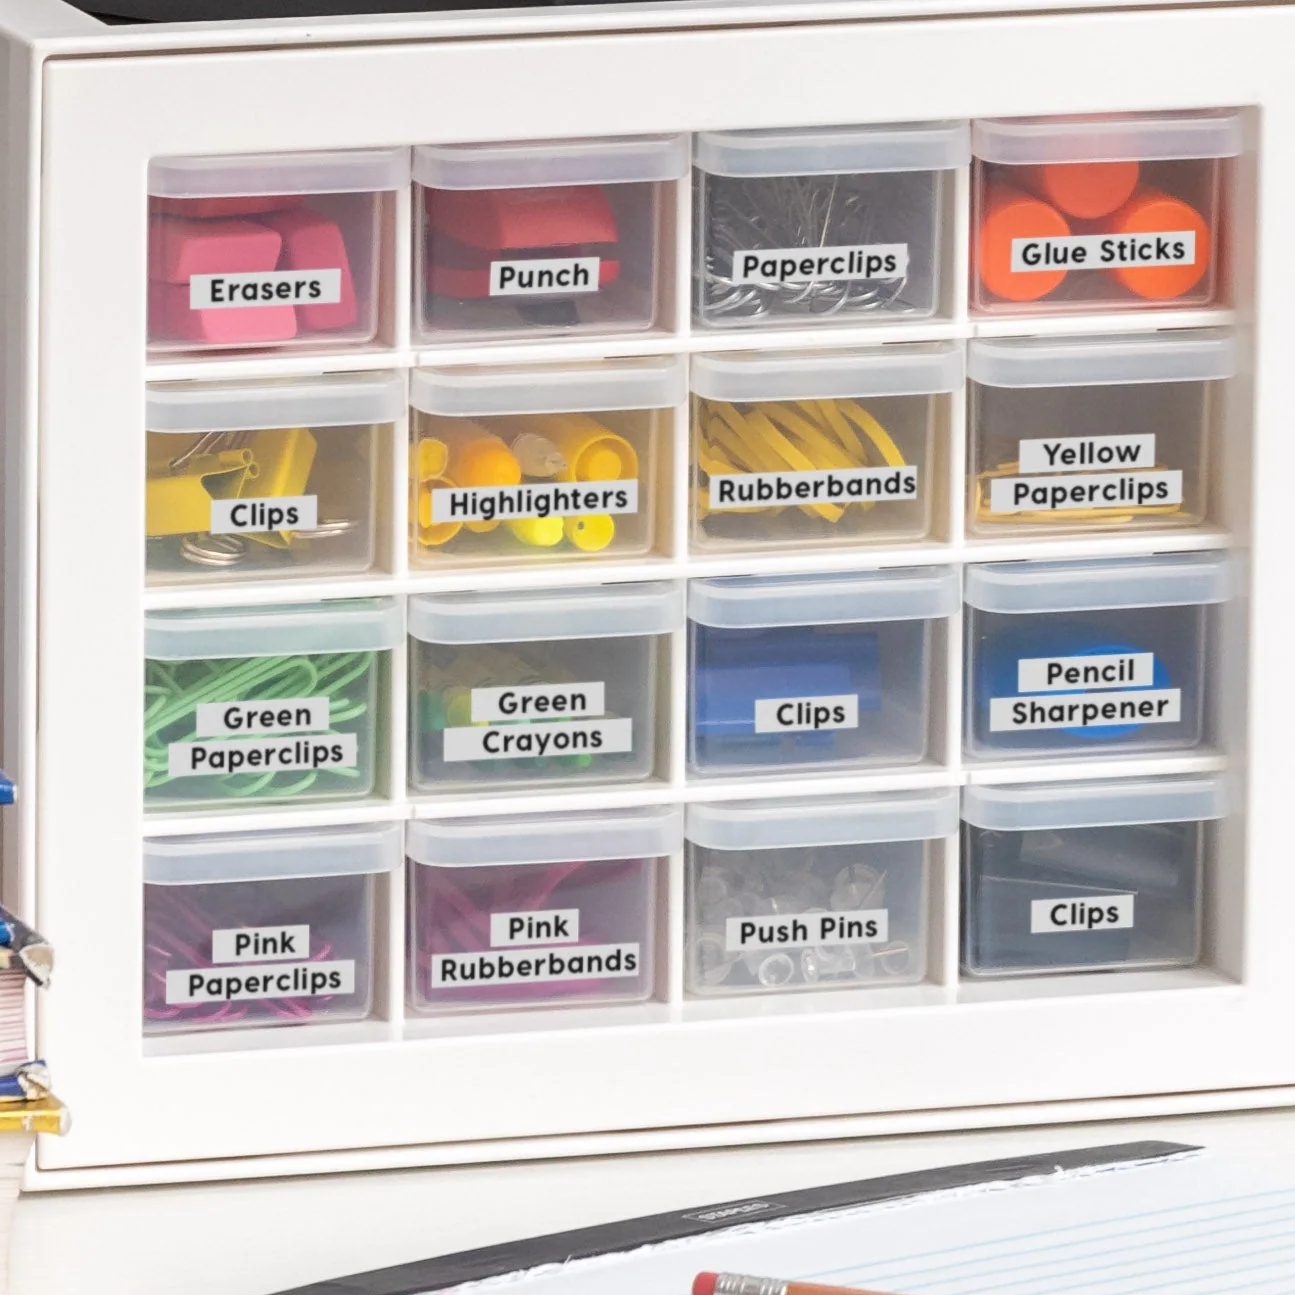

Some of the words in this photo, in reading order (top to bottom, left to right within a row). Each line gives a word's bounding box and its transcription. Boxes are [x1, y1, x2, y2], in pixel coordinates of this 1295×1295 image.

[1022, 242, 1087, 266] Glue
[1100, 237, 1185, 263] Sticks
[499, 263, 589, 289] Punch
[743, 250, 896, 282] Paperclips
[211, 278, 321, 303] Erasers
[1043, 441, 1141, 466] Yellow
[718, 472, 917, 502] Rubberbands
[1014, 477, 1168, 506] Paperclips
[230, 503, 299, 527] Clips
[450, 488, 628, 518] Highlighters
[1047, 658, 1134, 685] Pencil
[498, 692, 586, 715] Green
[776, 702, 845, 729] Clips
[1012, 699, 1169, 725] Sharpener
[223, 706, 311, 730] Green
[482, 730, 602, 754] Crayons
[191, 741, 343, 770] Paperclips
[509, 915, 569, 940] Pink
[1050, 903, 1119, 929] Clips
[235, 931, 295, 956] Pink
[740, 919, 808, 945] Push
[820, 916, 878, 940] Pins
[440, 949, 637, 982] Rubberbands
[189, 967, 342, 997] Paperclips
